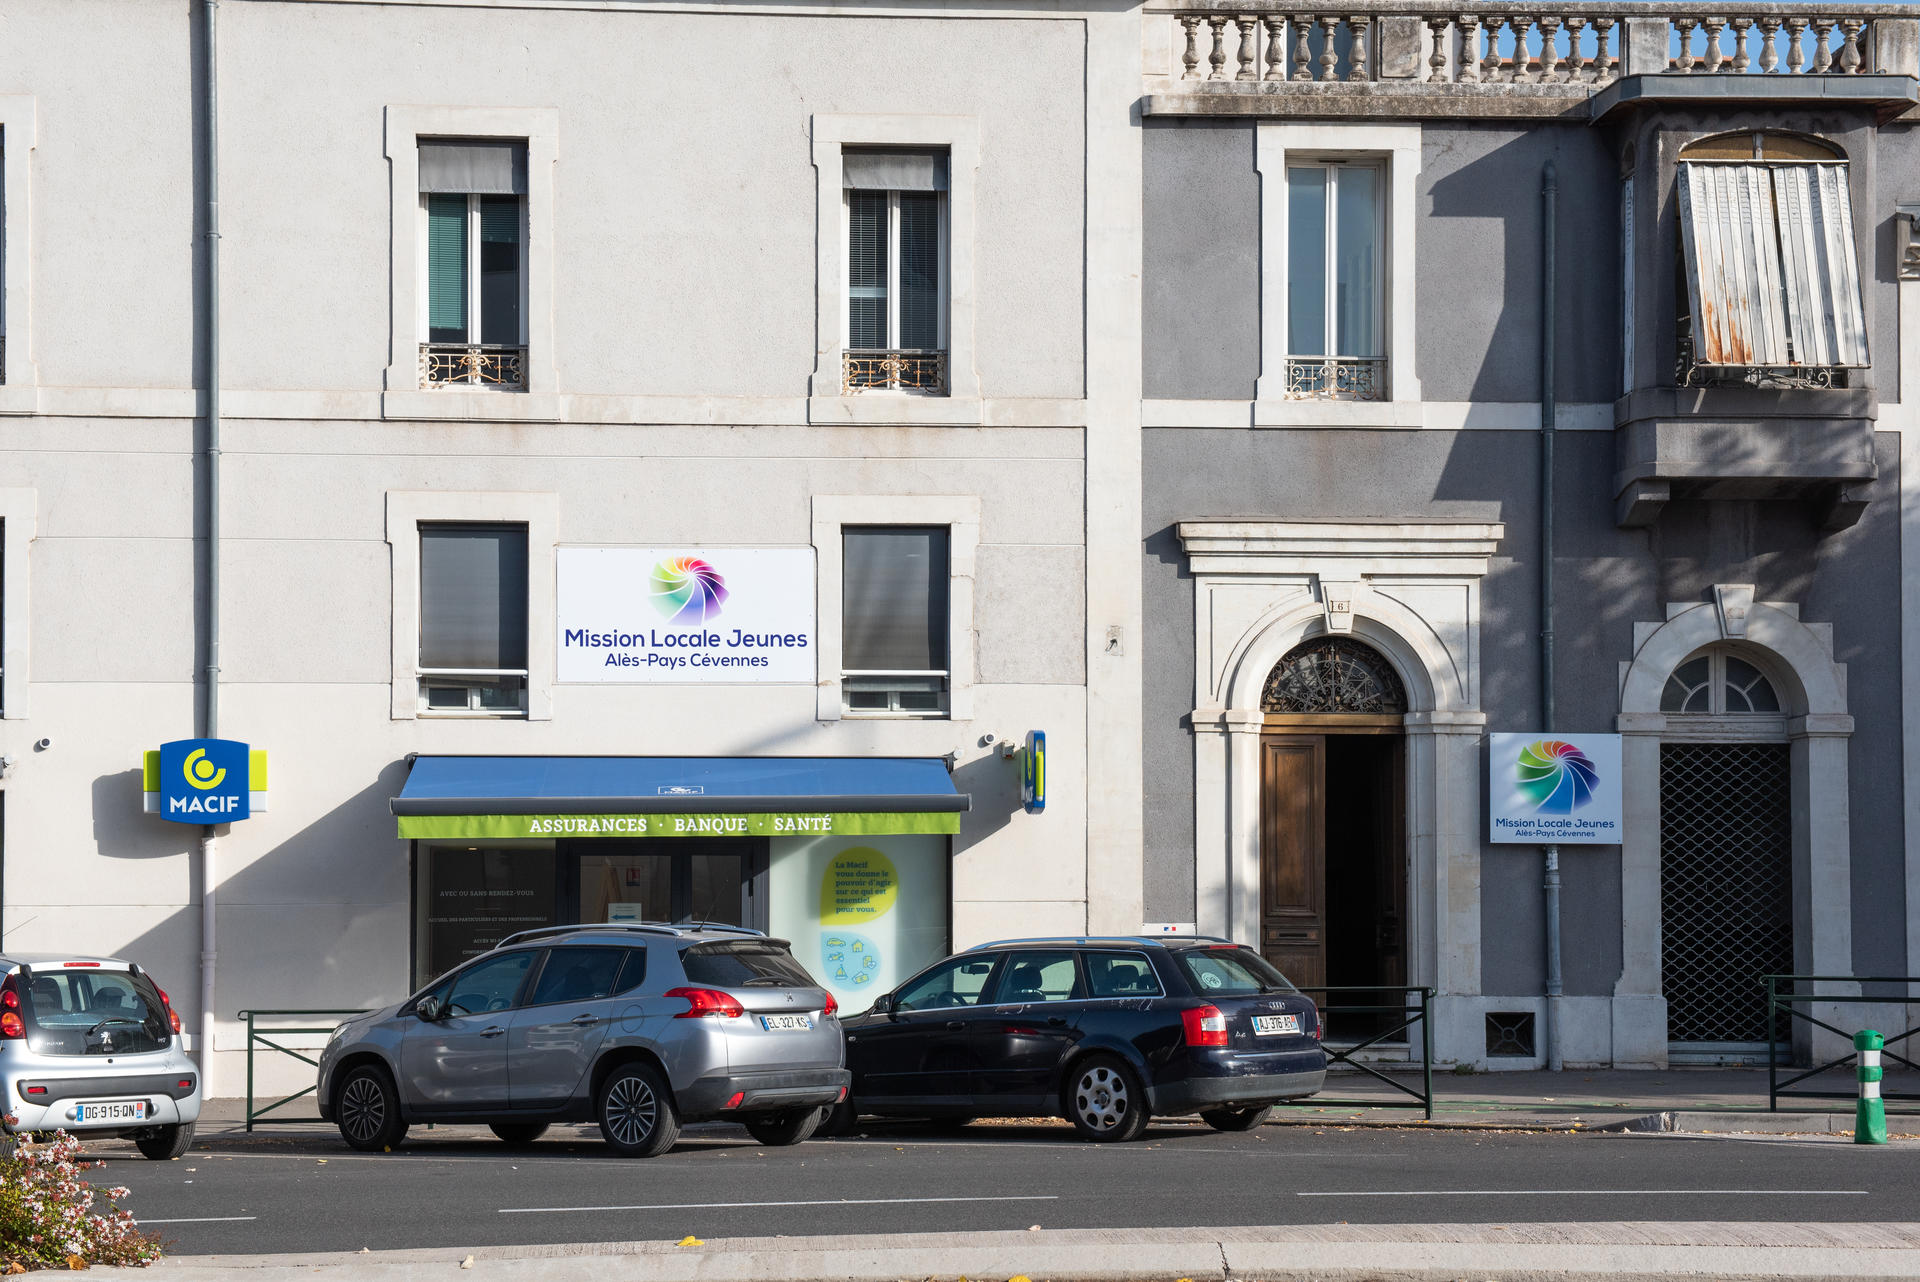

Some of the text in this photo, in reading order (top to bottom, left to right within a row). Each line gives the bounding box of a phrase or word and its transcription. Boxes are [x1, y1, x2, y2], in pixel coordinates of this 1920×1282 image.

[1337, 602, 1344, 611] 6
[565, 629, 808, 648] Mission Locale Jeunes
[604, 653, 769, 670] Alès-Pays Cévennes
[169, 796, 239, 813] MACIF
[529, 815, 832, 834] ASSURANCES BANQUE SANTÉ
[1495, 818, 1615, 828] Mission Locale Jeunes
[1515, 829, 1596, 838] Alès-Pays Cévennes
[860, 888, 874, 896] qui
[766, 1016, 808, 1029] EL-327-KS
[85, 1104, 135, 1119] DG-915-QN
